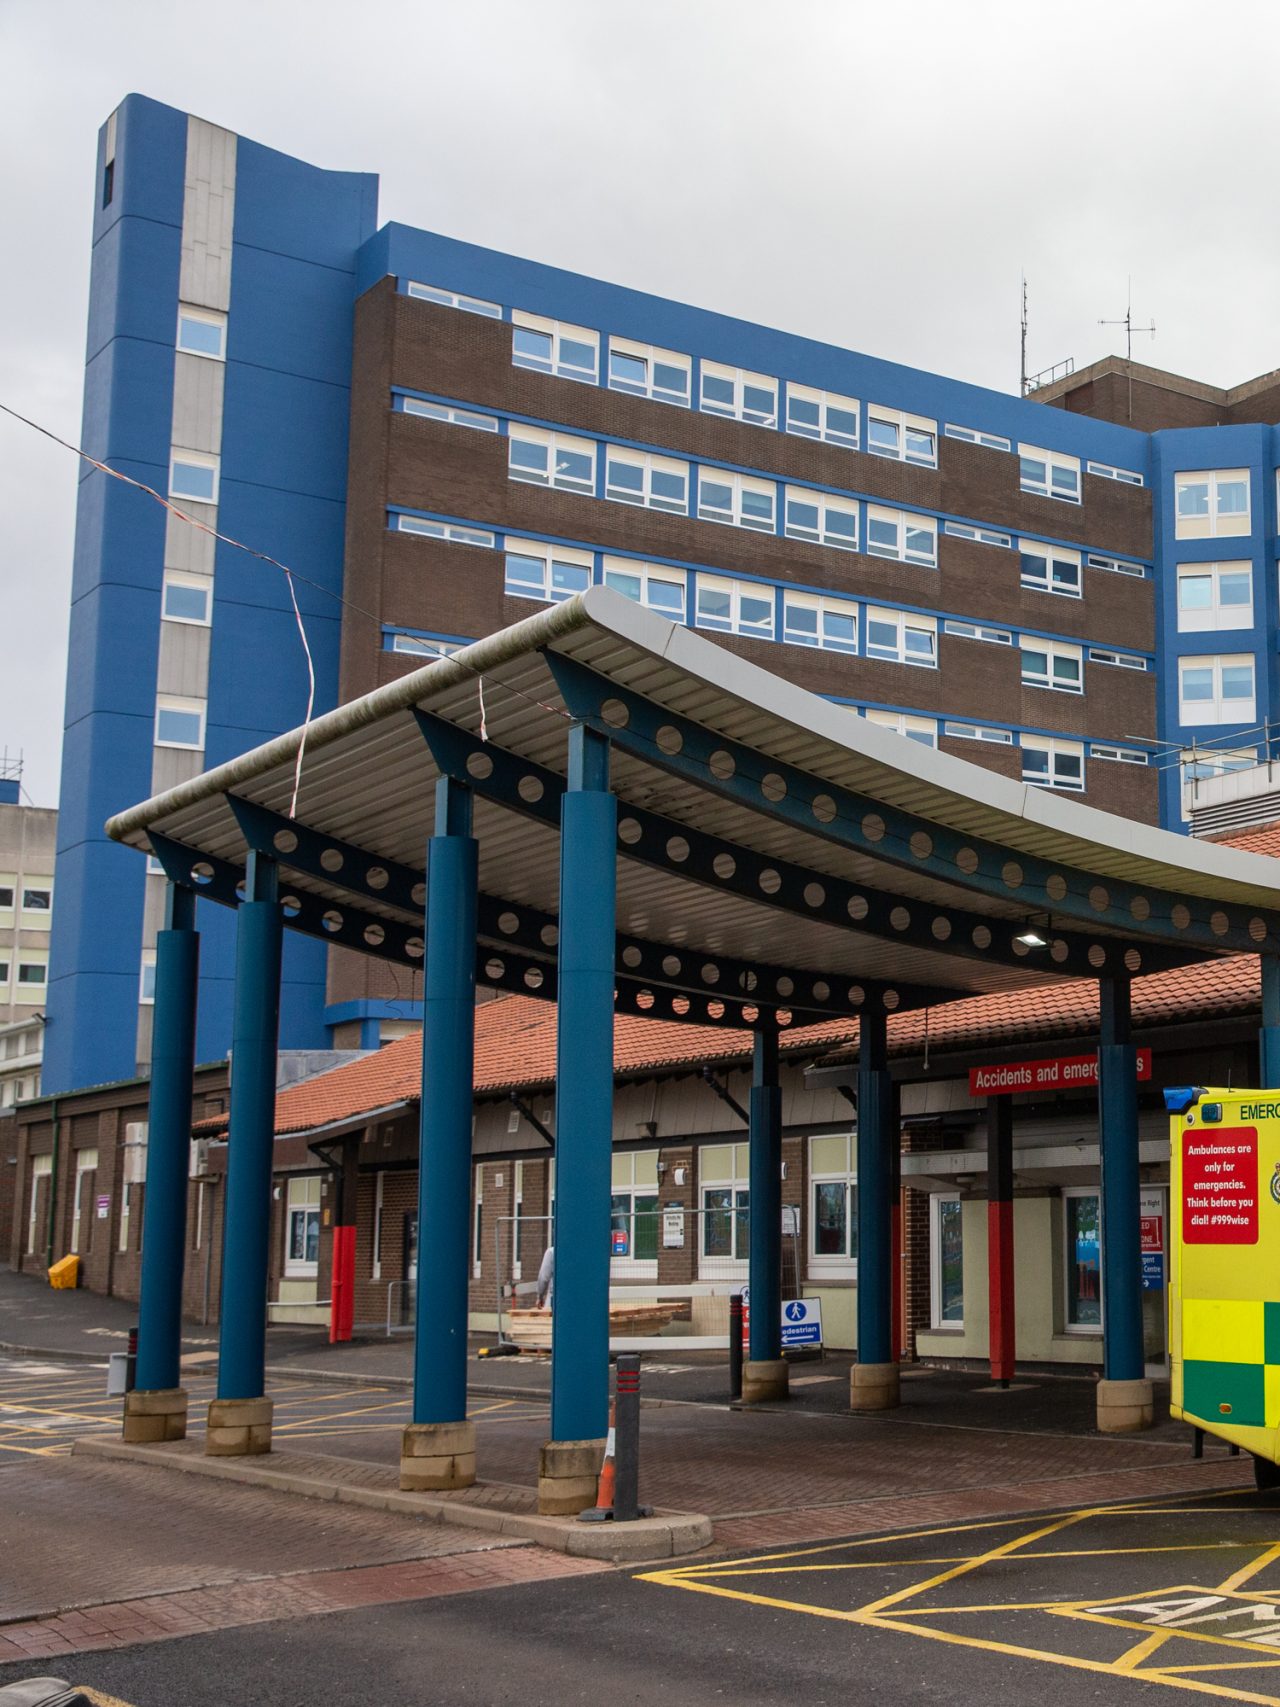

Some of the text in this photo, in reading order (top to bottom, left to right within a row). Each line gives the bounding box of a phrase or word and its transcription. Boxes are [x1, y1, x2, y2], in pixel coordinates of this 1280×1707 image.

[976, 1067, 1032, 1088] Accidents
[1037, 1063, 1059, 1082] and
[1188, 1145, 1251, 1155] Ambulances are
[1204, 1161, 1235, 1174] only for
[1194, 1180, 1246, 1192] emergencies.
[1187, 1197, 1253, 1209] Think before you
[1191, 1214, 1249, 1225] dial! #999wise
[782, 1325, 817, 1336] edestrian
